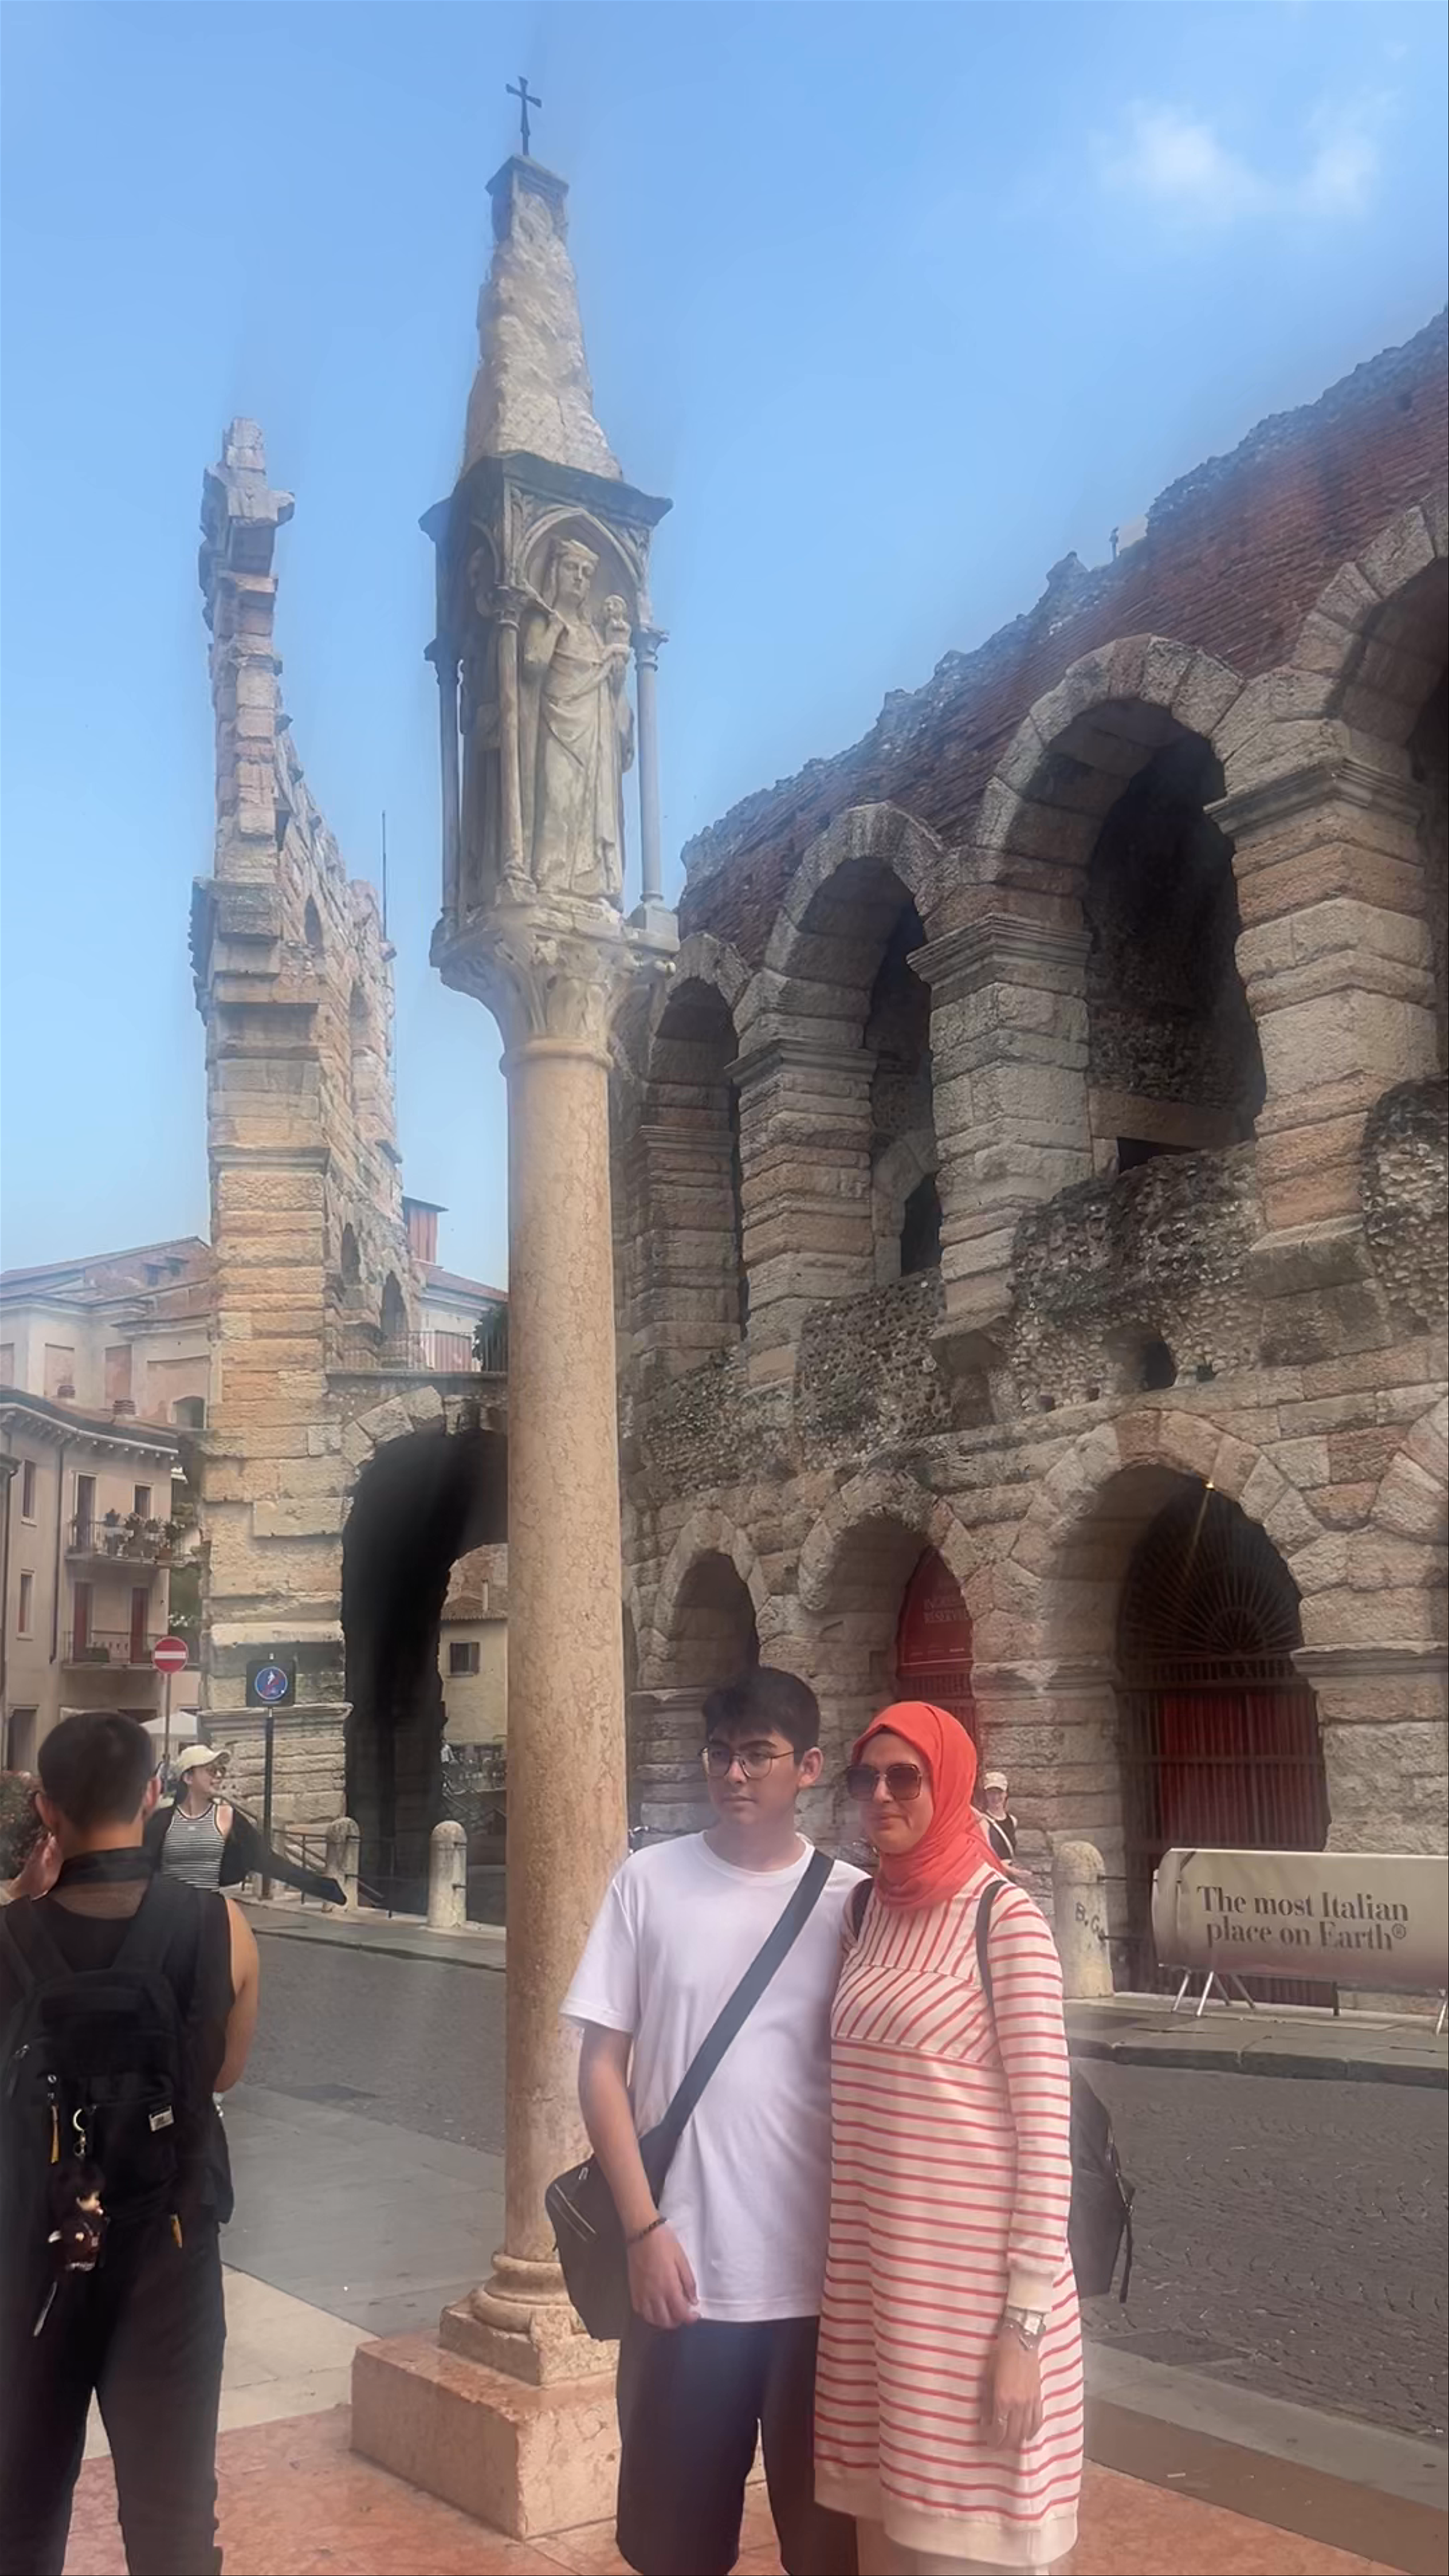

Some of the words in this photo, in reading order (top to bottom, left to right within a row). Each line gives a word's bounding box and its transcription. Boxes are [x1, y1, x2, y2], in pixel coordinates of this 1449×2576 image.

[1197, 1886, 1246, 1913] The
[1255, 1895, 1313, 1918] most
[1321, 1892, 1408, 1921] Italian
[1206, 1915, 1272, 1948] place
[1280, 1925, 1310, 1946] on
